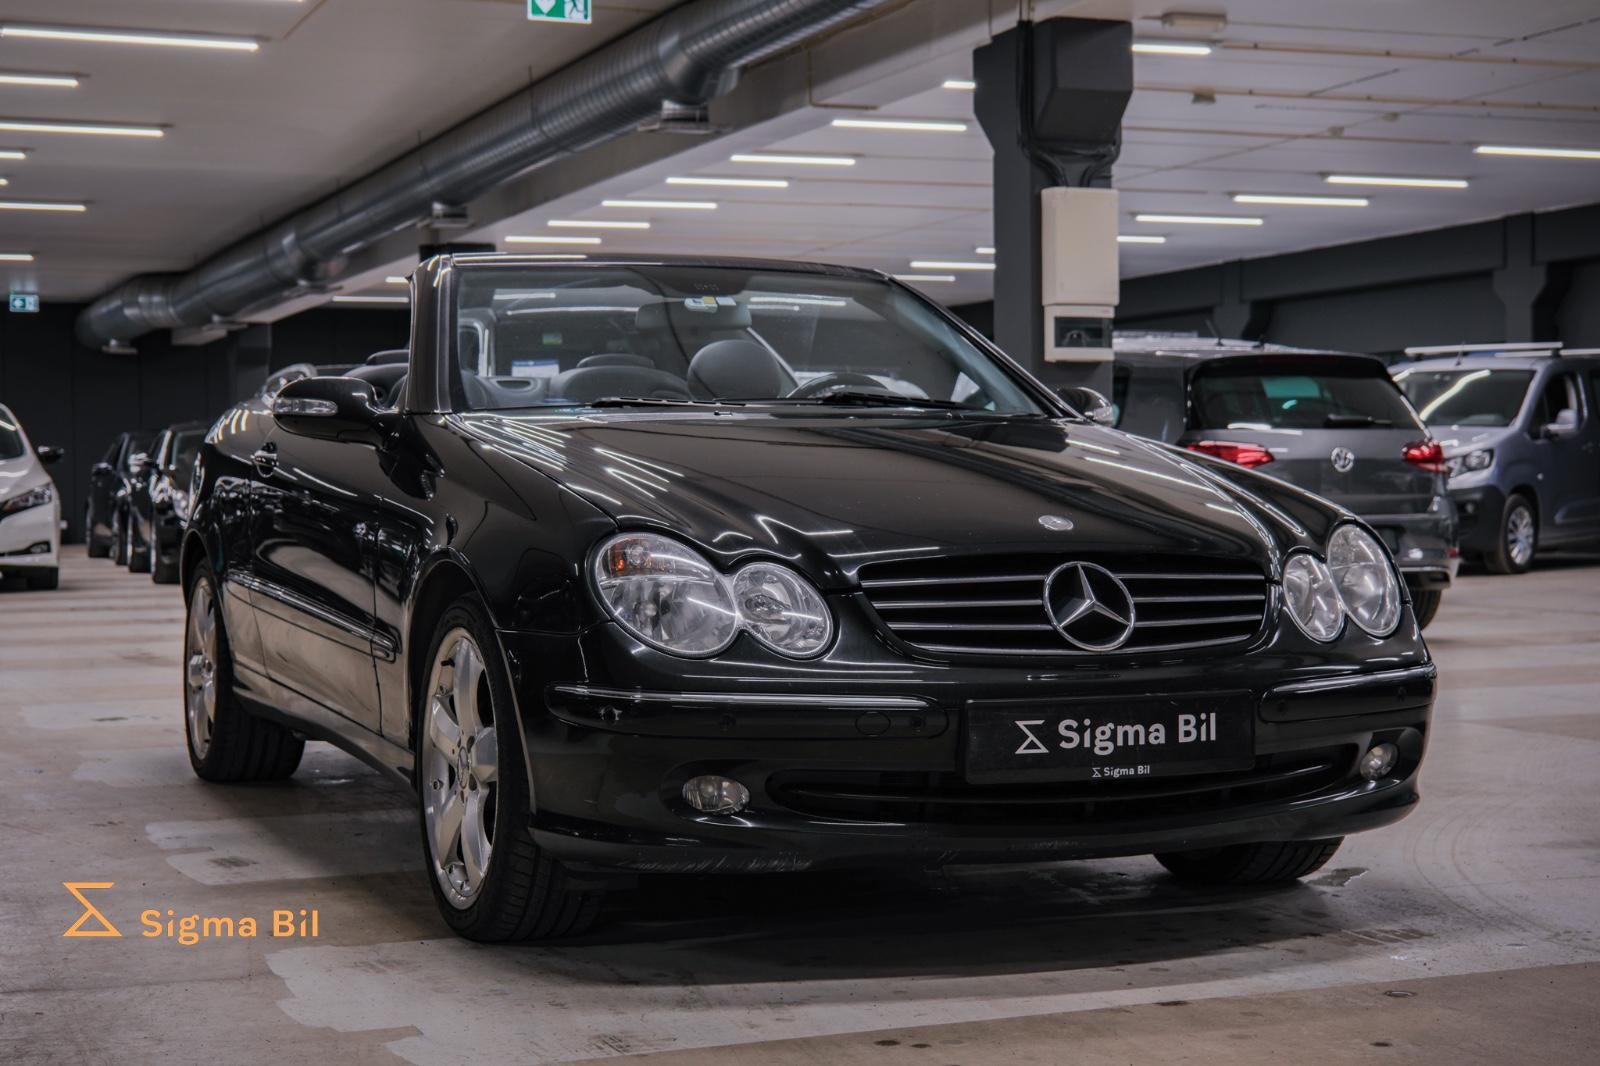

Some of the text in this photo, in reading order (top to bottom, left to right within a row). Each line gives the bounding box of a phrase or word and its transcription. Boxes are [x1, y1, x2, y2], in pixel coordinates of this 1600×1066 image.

[1057, 712, 1217, 756] Sigma Bil
[1103, 764, 1151, 778] Sigma Bil
